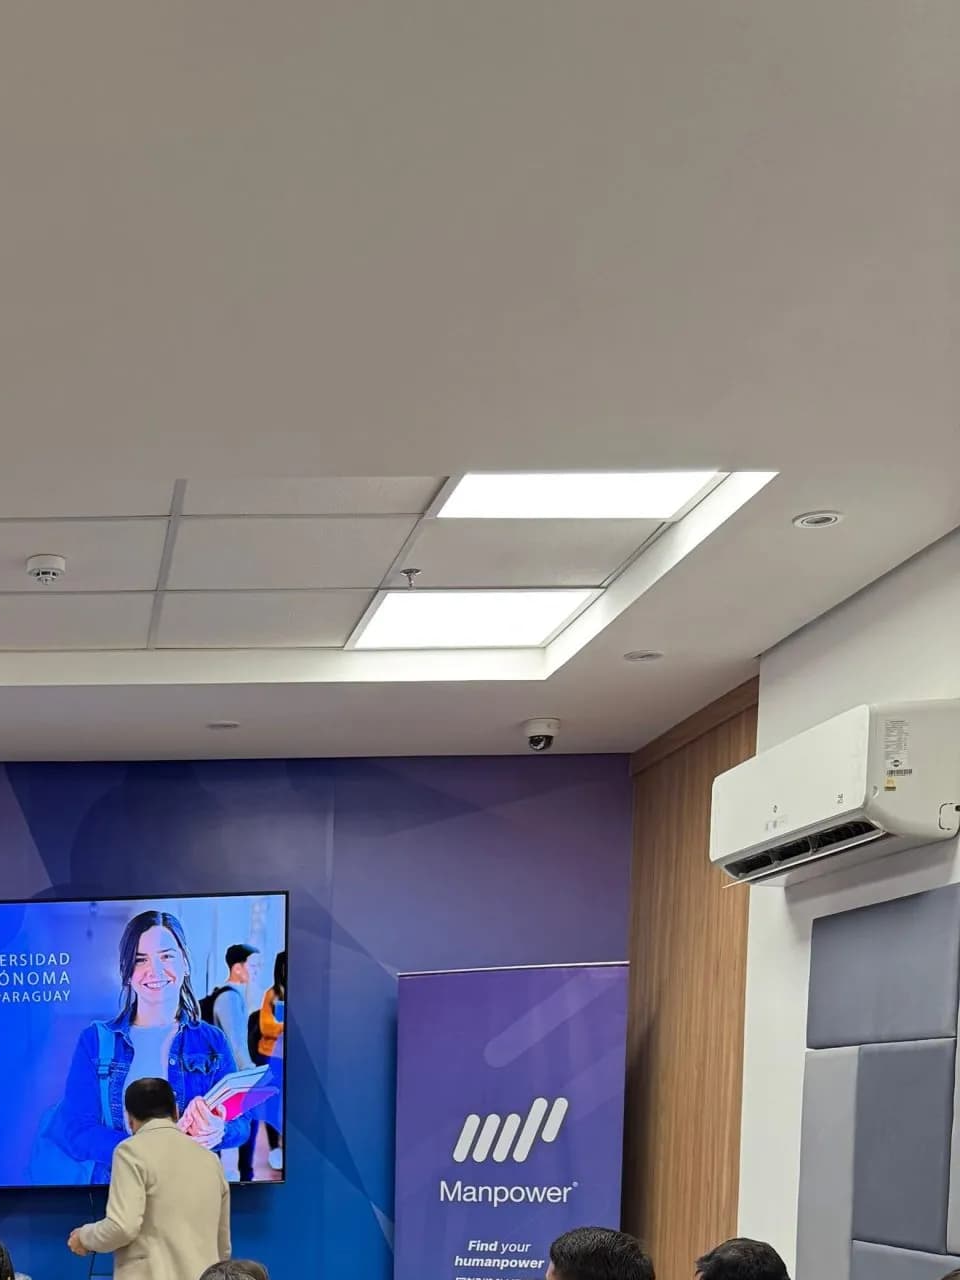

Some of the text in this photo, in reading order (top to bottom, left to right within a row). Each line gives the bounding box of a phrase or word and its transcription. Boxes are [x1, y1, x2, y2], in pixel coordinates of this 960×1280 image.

[440, 1180, 572, 1208] Manpower
[468, 1240, 532, 1255] Find your
[454, 1256, 545, 1270] humanpower
